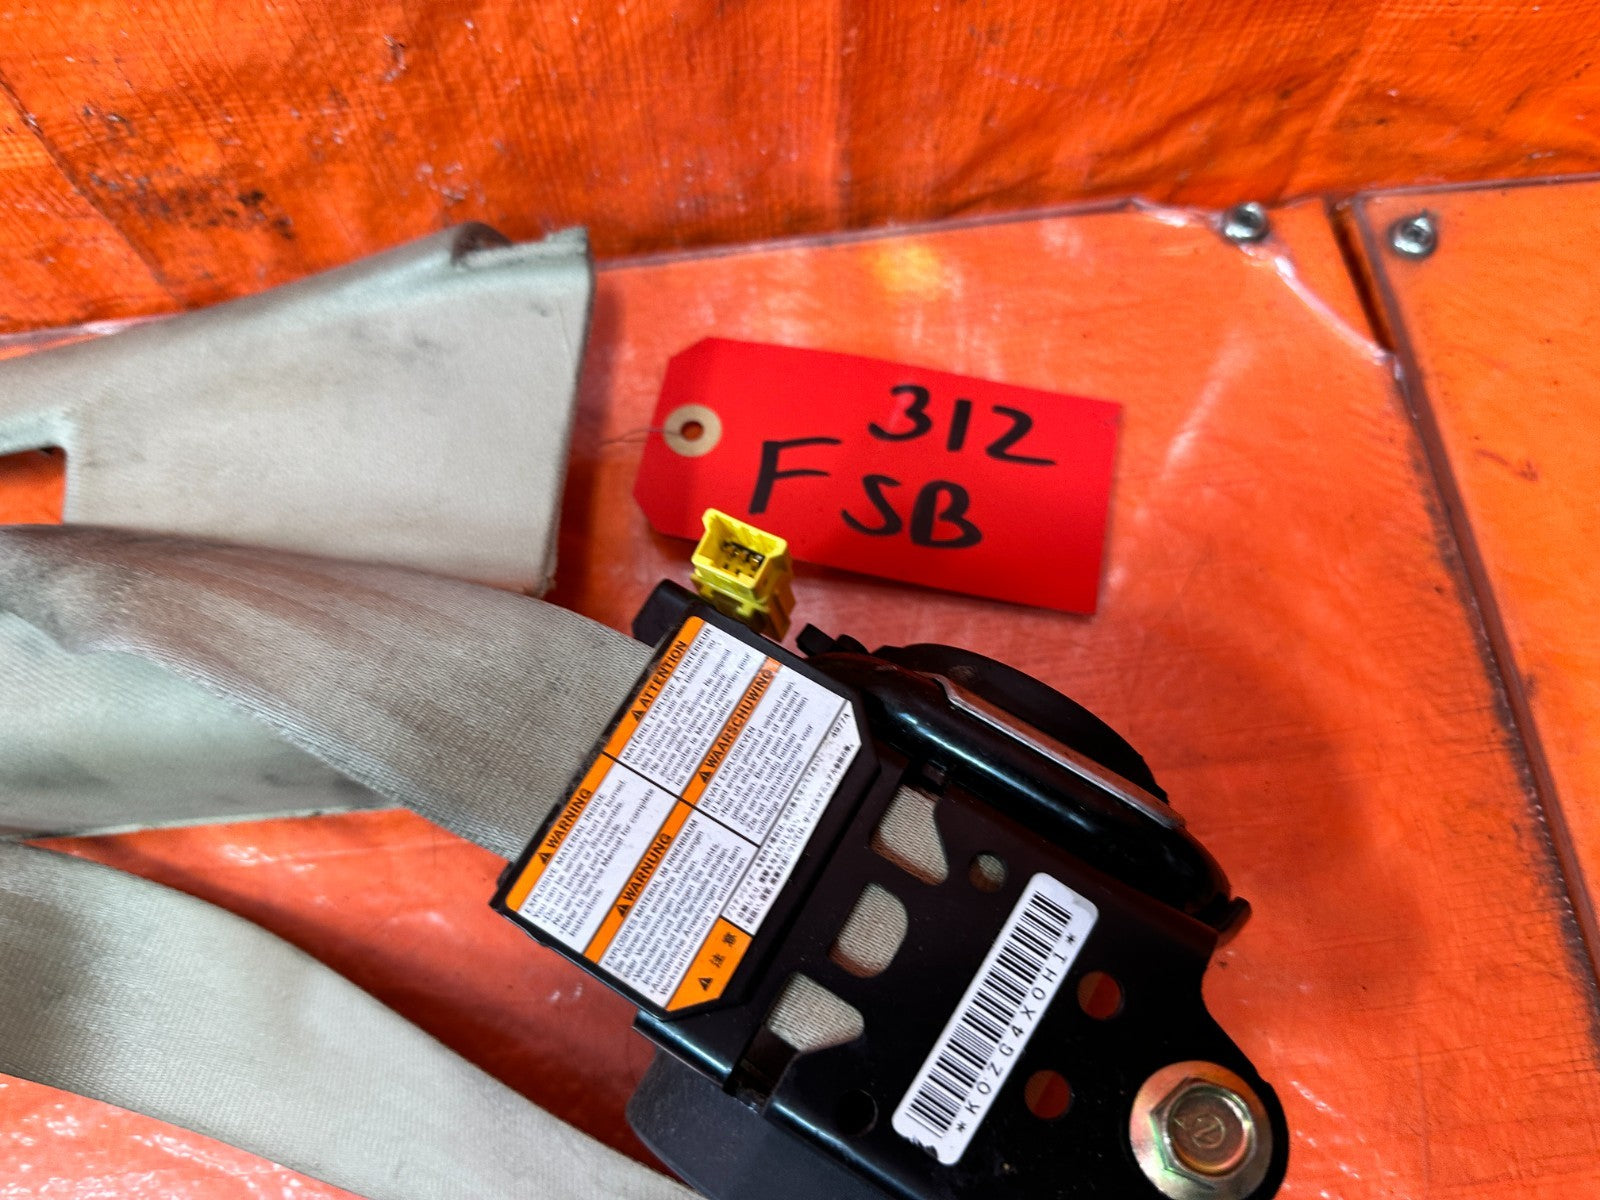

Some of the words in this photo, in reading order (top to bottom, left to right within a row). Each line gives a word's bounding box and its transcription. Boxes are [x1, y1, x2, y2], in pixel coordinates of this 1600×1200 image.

[868, 384, 1056, 466] 312
[748, 437, 842, 514] F
[841, 474, 982, 549] SB
[636, 638, 688, 708] ATTENTION
[647, 682, 676, 720] EXPLOSIF
[704, 666, 774, 770] WAARSCHUWING
[700, 780, 721, 808] BEVAT
[717, 724, 756, 780] EXPLOSIEVEN
[523, 865, 558, 914] EXPLOSIVE
[553, 823, 585, 866] MATERIAL
[582, 791, 606, 822] INSIDE
[545, 785, 592, 850] WARNING
[560, 908, 578, 931] Refer
[581, 866, 605, 897] Service
[599, 835, 624, 867] Manual
[619, 822, 632, 836] for
[626, 786, 656, 824] complete
[531, 901, 548, 919] You
[544, 885, 558, 902] can
[561, 836, 590, 874] seriously
[584, 818, 600, 836] hurt
[552, 891, 565, 906] not
[562, 860, 586, 891] tamper
[604, 917, 638, 967] EXPLOSIVES
[633, 879, 661, 918] MATERIAL
[664, 817, 699, 866] INNENRAUM
[622, 830, 672, 904] WARNUNG
[551, 911, 564, 926] No
[708, 930, 739, 968] 注意
